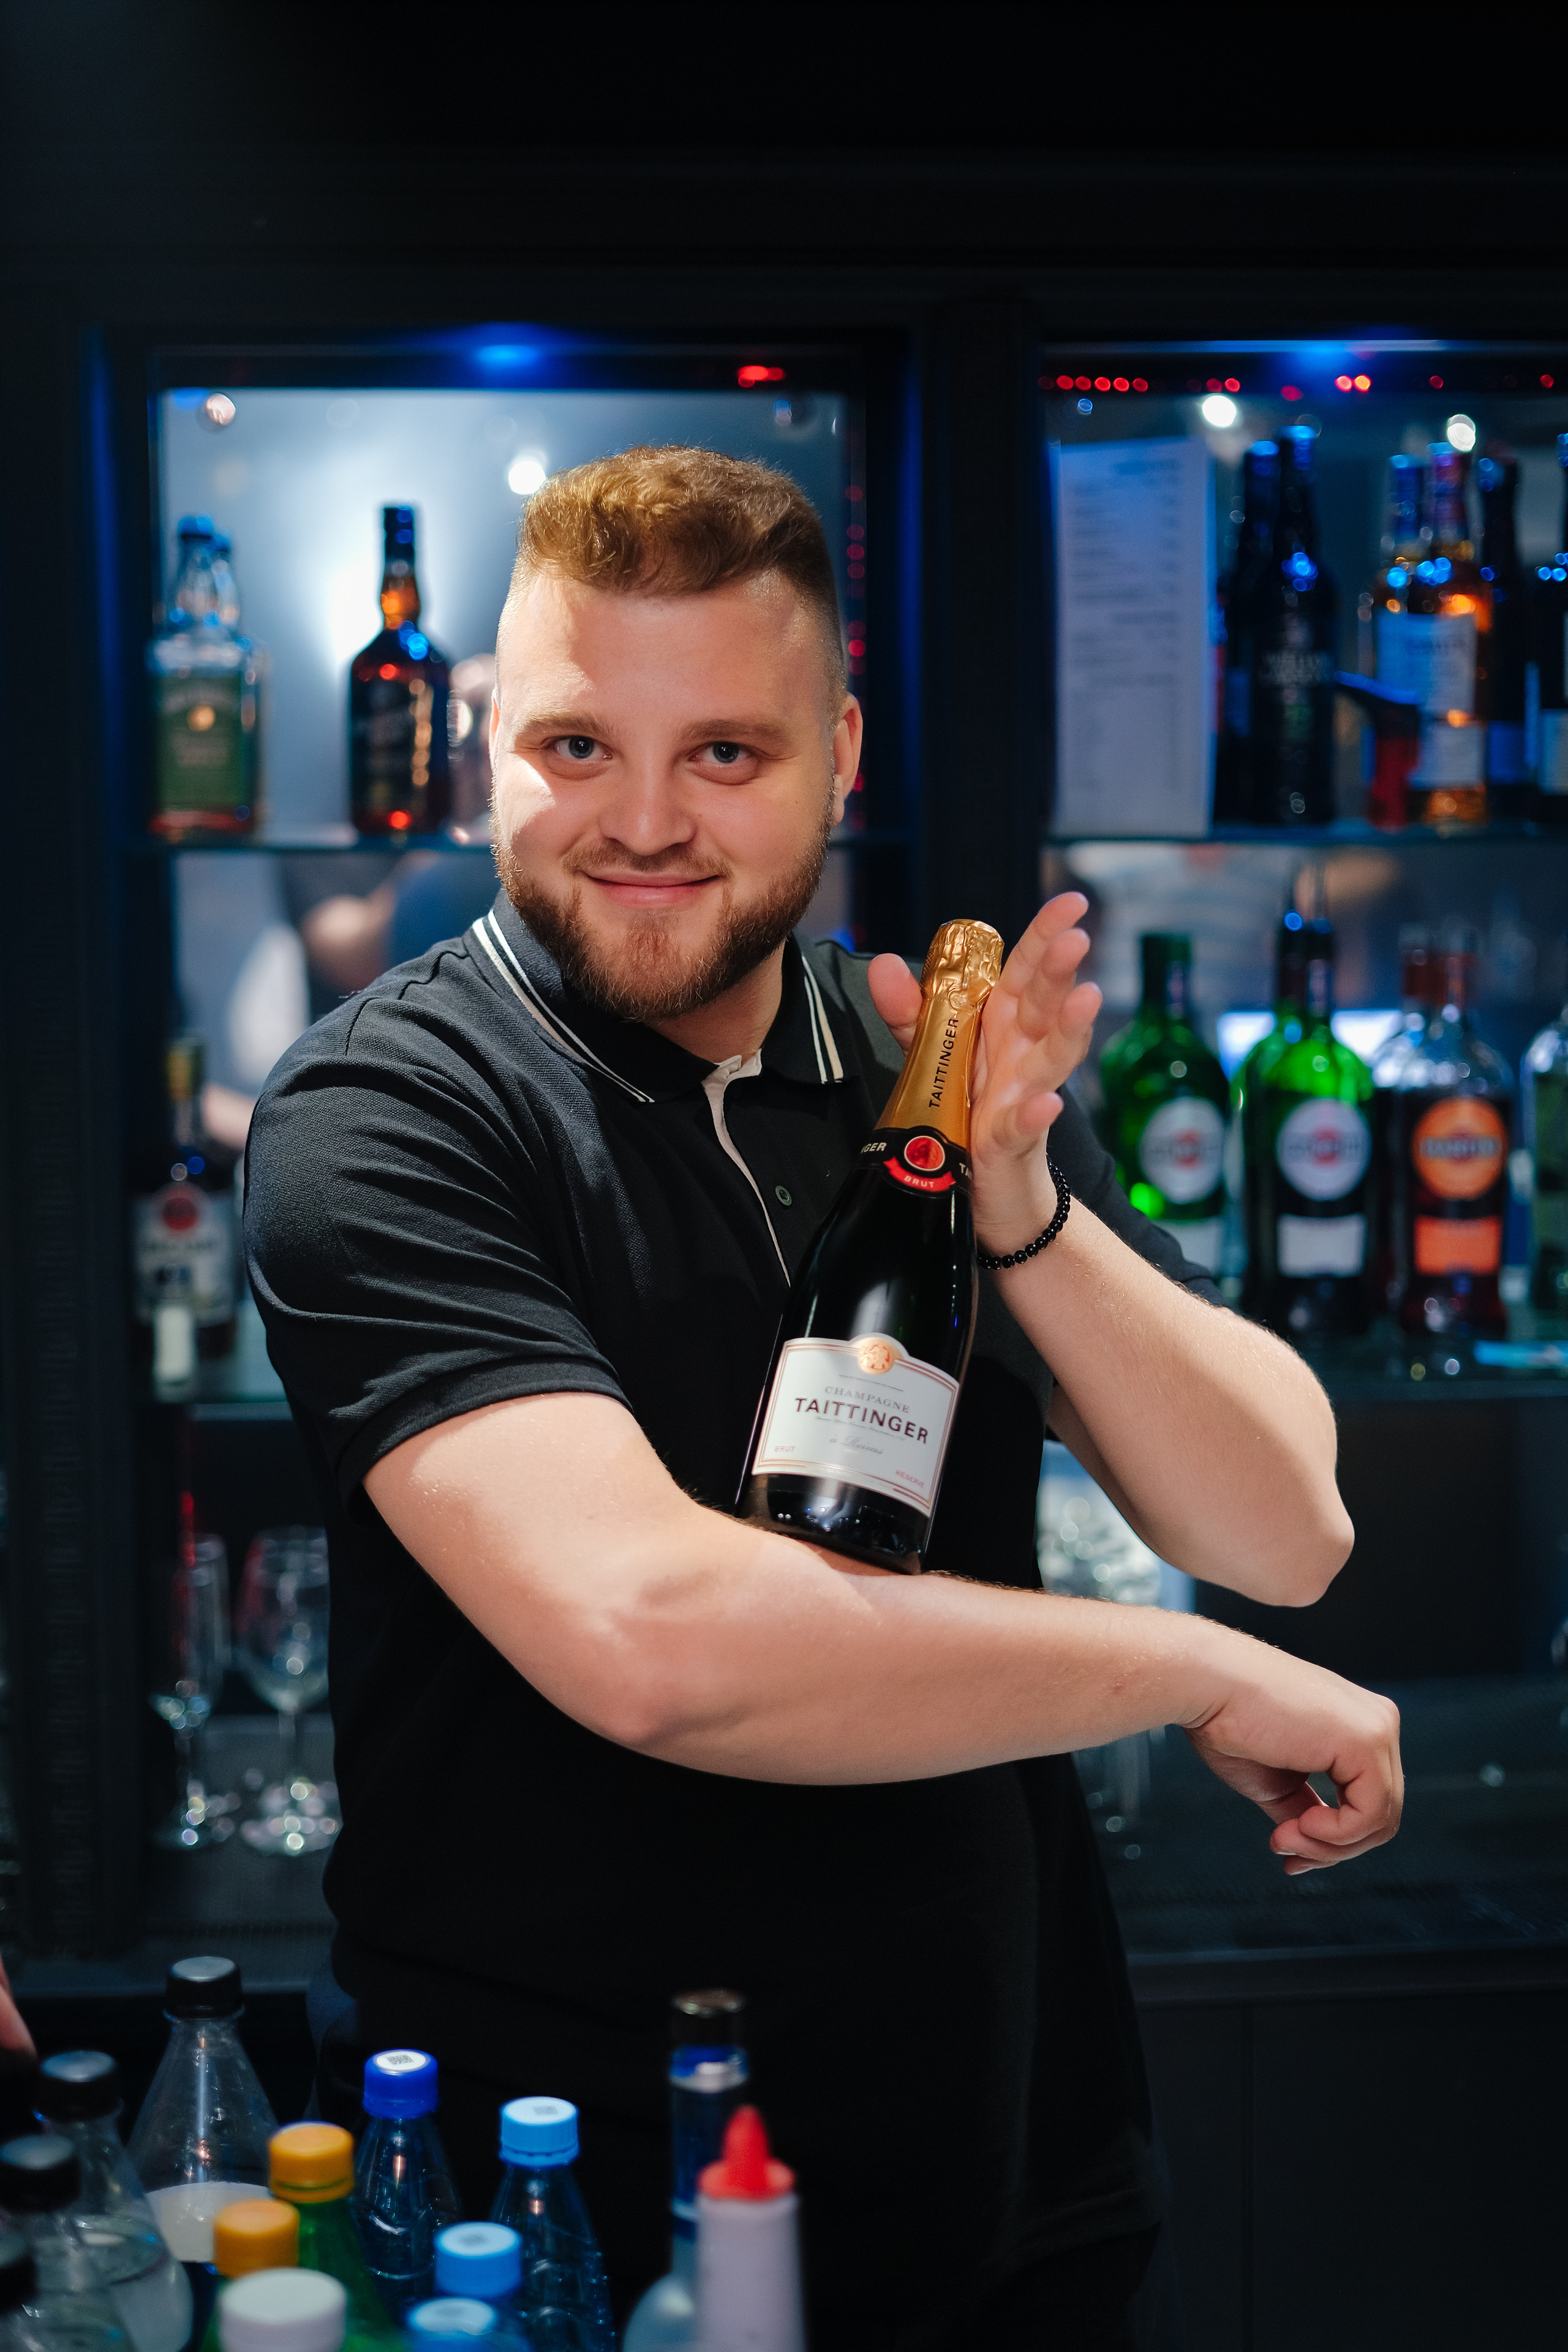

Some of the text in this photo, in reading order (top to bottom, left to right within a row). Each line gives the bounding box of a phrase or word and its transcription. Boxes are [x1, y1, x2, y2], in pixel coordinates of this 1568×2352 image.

[929, 1018, 959, 1109] TAITTINGER
[904, 1175, 935, 1188] BRUT
[825, 1386, 910, 1413] CHAMPAGNE
[795, 1397, 929, 1444] TAITTINGER
